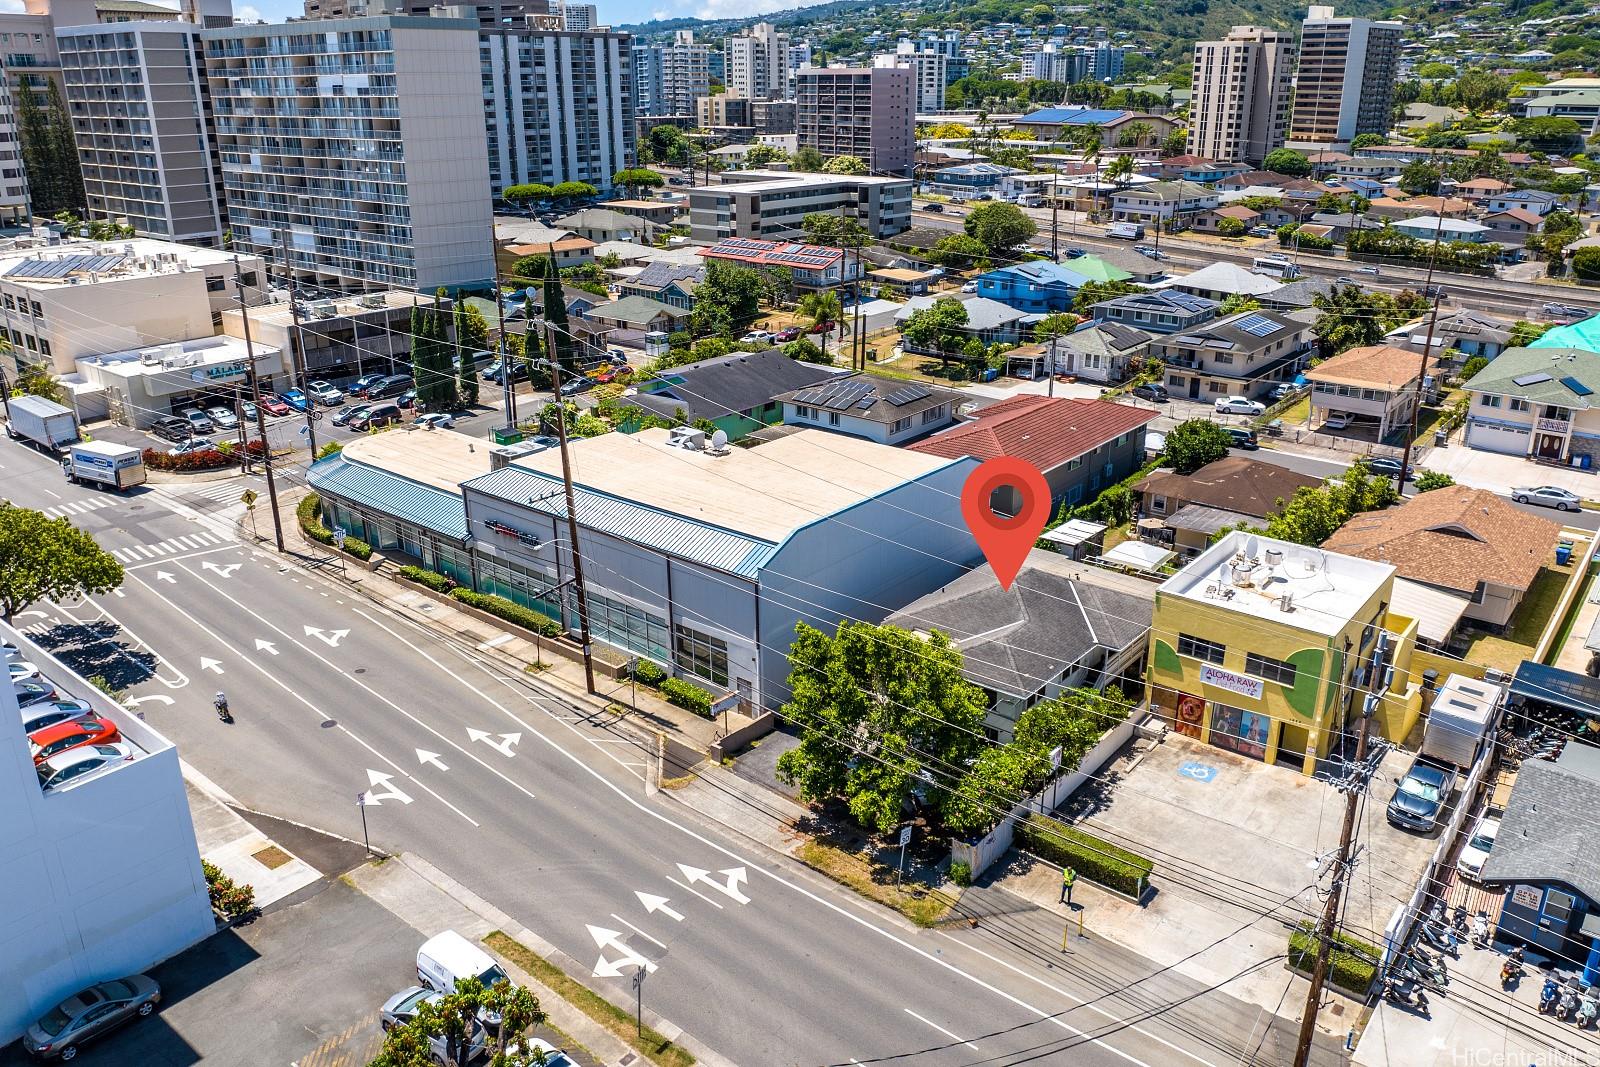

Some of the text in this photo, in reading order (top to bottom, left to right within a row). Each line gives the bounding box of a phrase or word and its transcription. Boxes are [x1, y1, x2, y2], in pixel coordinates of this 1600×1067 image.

[1206, 668, 1258, 689] ALOHA RAW
[1518, 889, 1538, 899] OPEN
